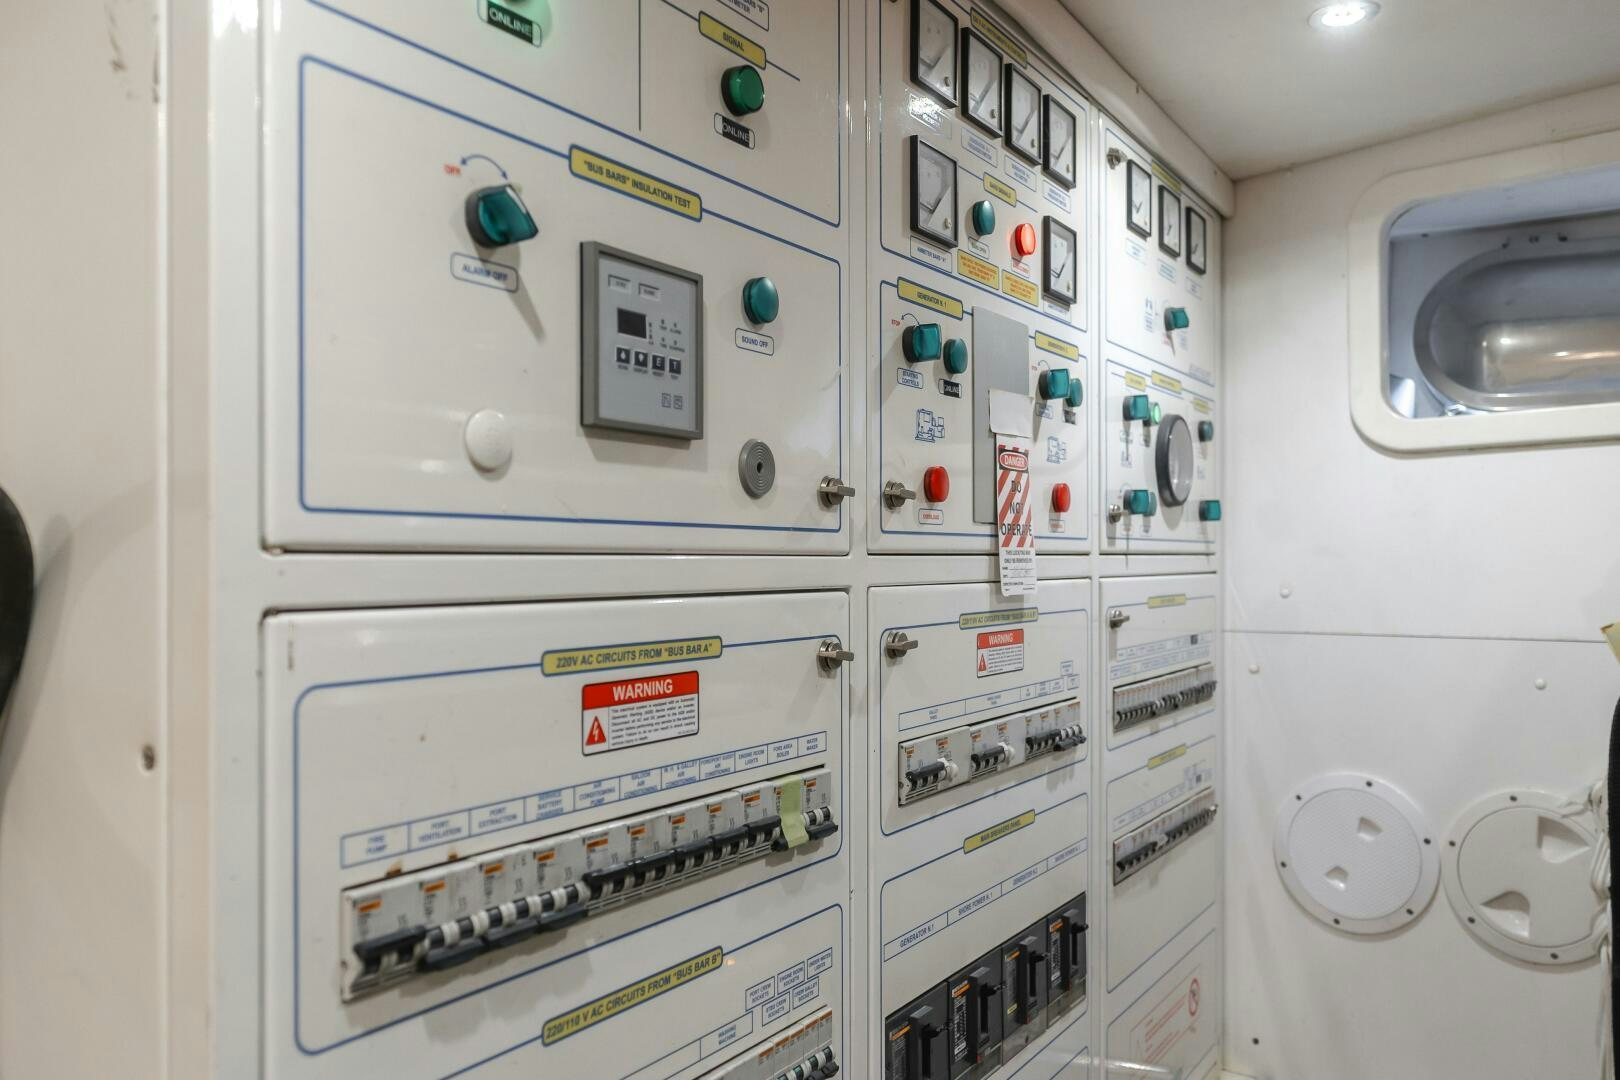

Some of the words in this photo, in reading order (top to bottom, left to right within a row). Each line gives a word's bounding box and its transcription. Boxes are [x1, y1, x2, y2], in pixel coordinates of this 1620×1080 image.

[489, 7, 532, 37] ONLINE
[722, 32, 744, 50] SIGNAL
[722, 123, 749, 143] ONLINE
[632, 179, 673, 202] INSULATION
[674, 195, 691, 209] TEST
[742, 336, 758, 346] SOUND
[759, 340, 769, 349] OFF
[1004, 455, 1026, 467] DANGER
[1011, 480, 1022, 493] DO
[1009, 502, 1024, 515] NOT
[1001, 524, 1033, 537] OPERATE
[988, 633, 1014, 646] WARNING
[556, 657, 578, 669] 220V
[580, 654, 593, 665] AC
[595, 650, 637, 664] CIRCUITS
[638, 648, 663, 660] FROM
[664, 646, 685, 658] "BUS
[686, 645, 702, 655] BAR
[612, 679, 673, 701] WARNING
[900, 927, 927, 947] GENERATOR
[546, 1014, 581, 1040] 220/110
[582, 1012, 590, 1022] V
[591, 1006, 604, 1019] AC
[606, 986, 646, 1012] CIRCUITS
[647, 975, 671, 993] FROM
[673, 966, 693, 980] "BUS
[694, 959, 710, 972] BAR
